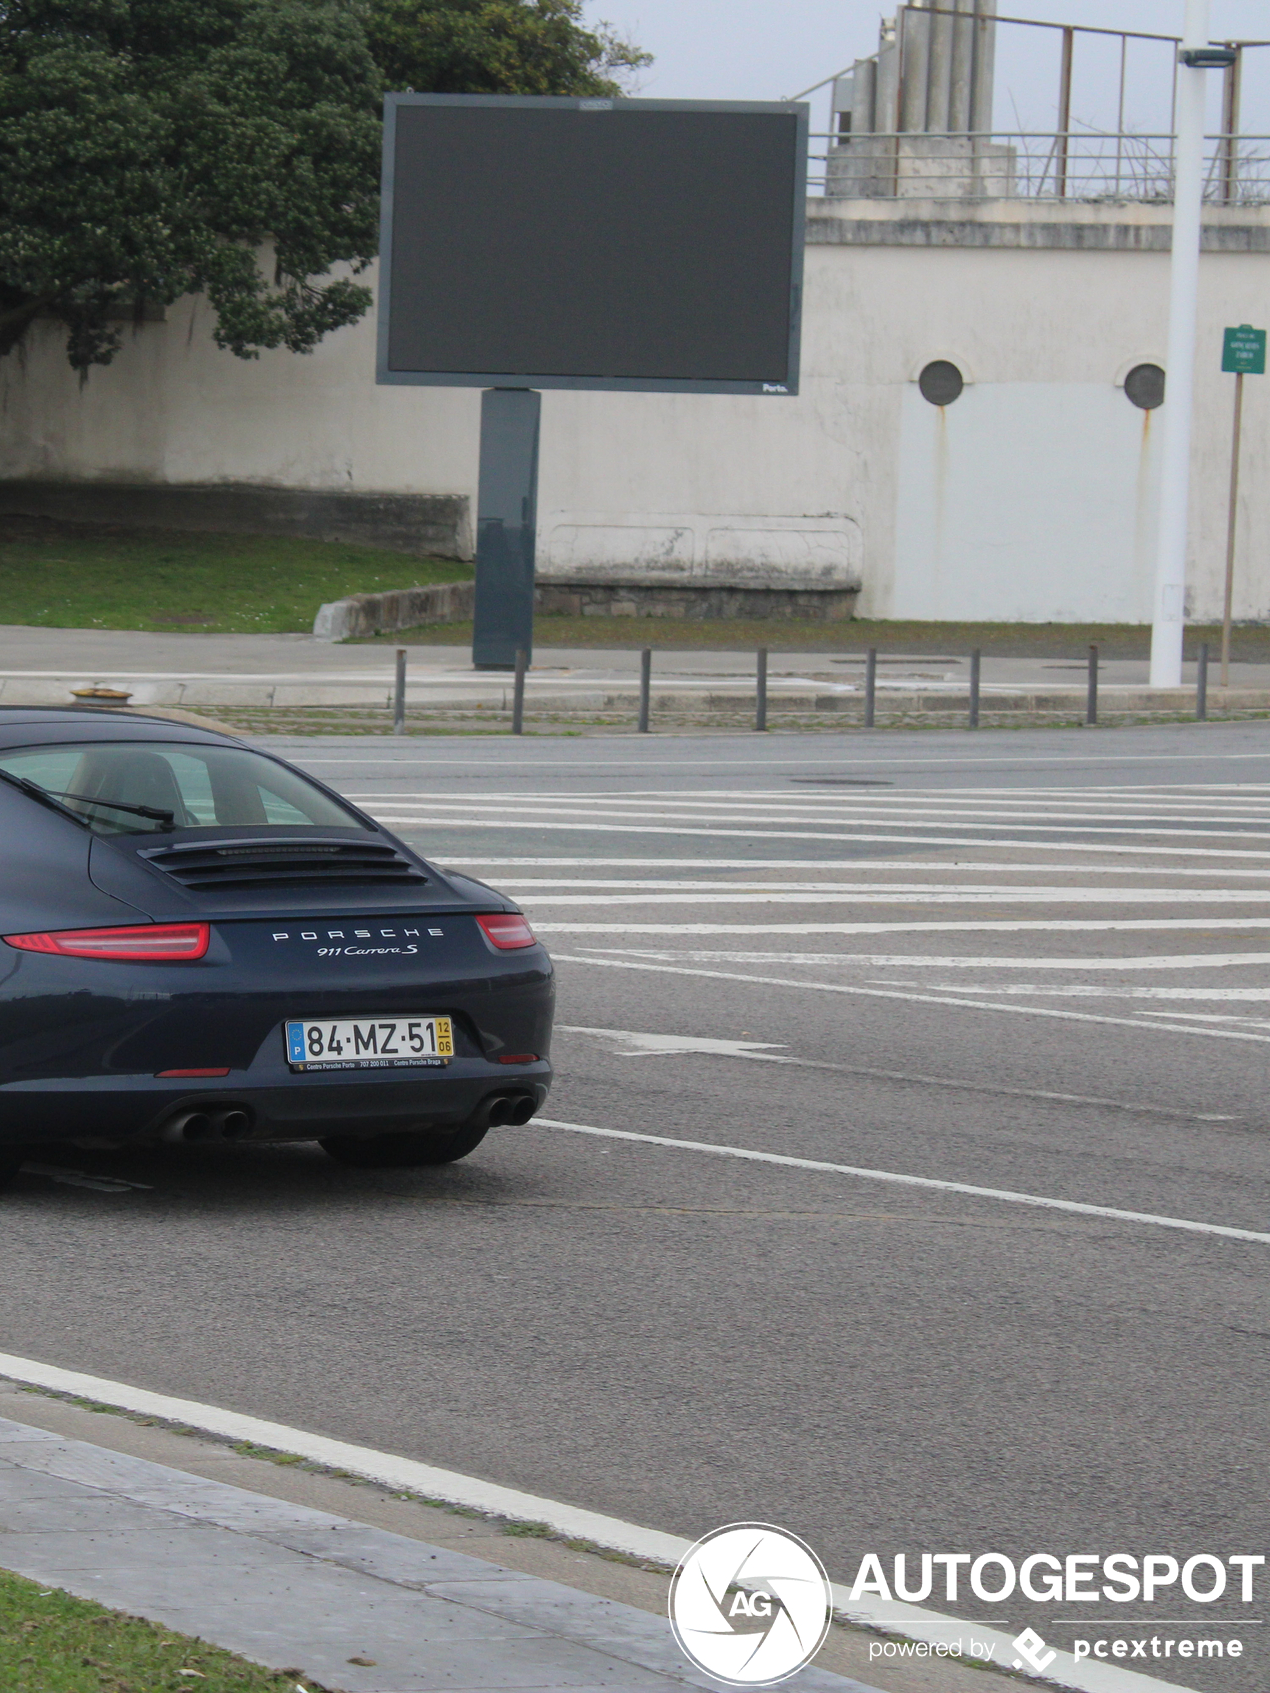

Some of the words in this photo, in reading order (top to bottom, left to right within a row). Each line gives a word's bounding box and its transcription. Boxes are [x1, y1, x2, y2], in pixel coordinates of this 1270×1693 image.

[272, 928, 444, 942] PORSCHE
[317, 947, 342, 957] 911
[344, 946, 401, 956] Carrera
[402, 944, 418, 954] S
[438, 1021, 450, 1033] 12
[294, 1046, 301, 1055] P
[438, 1041, 451, 1052] 06
[323, 1062, 341, 1070] Porsche
